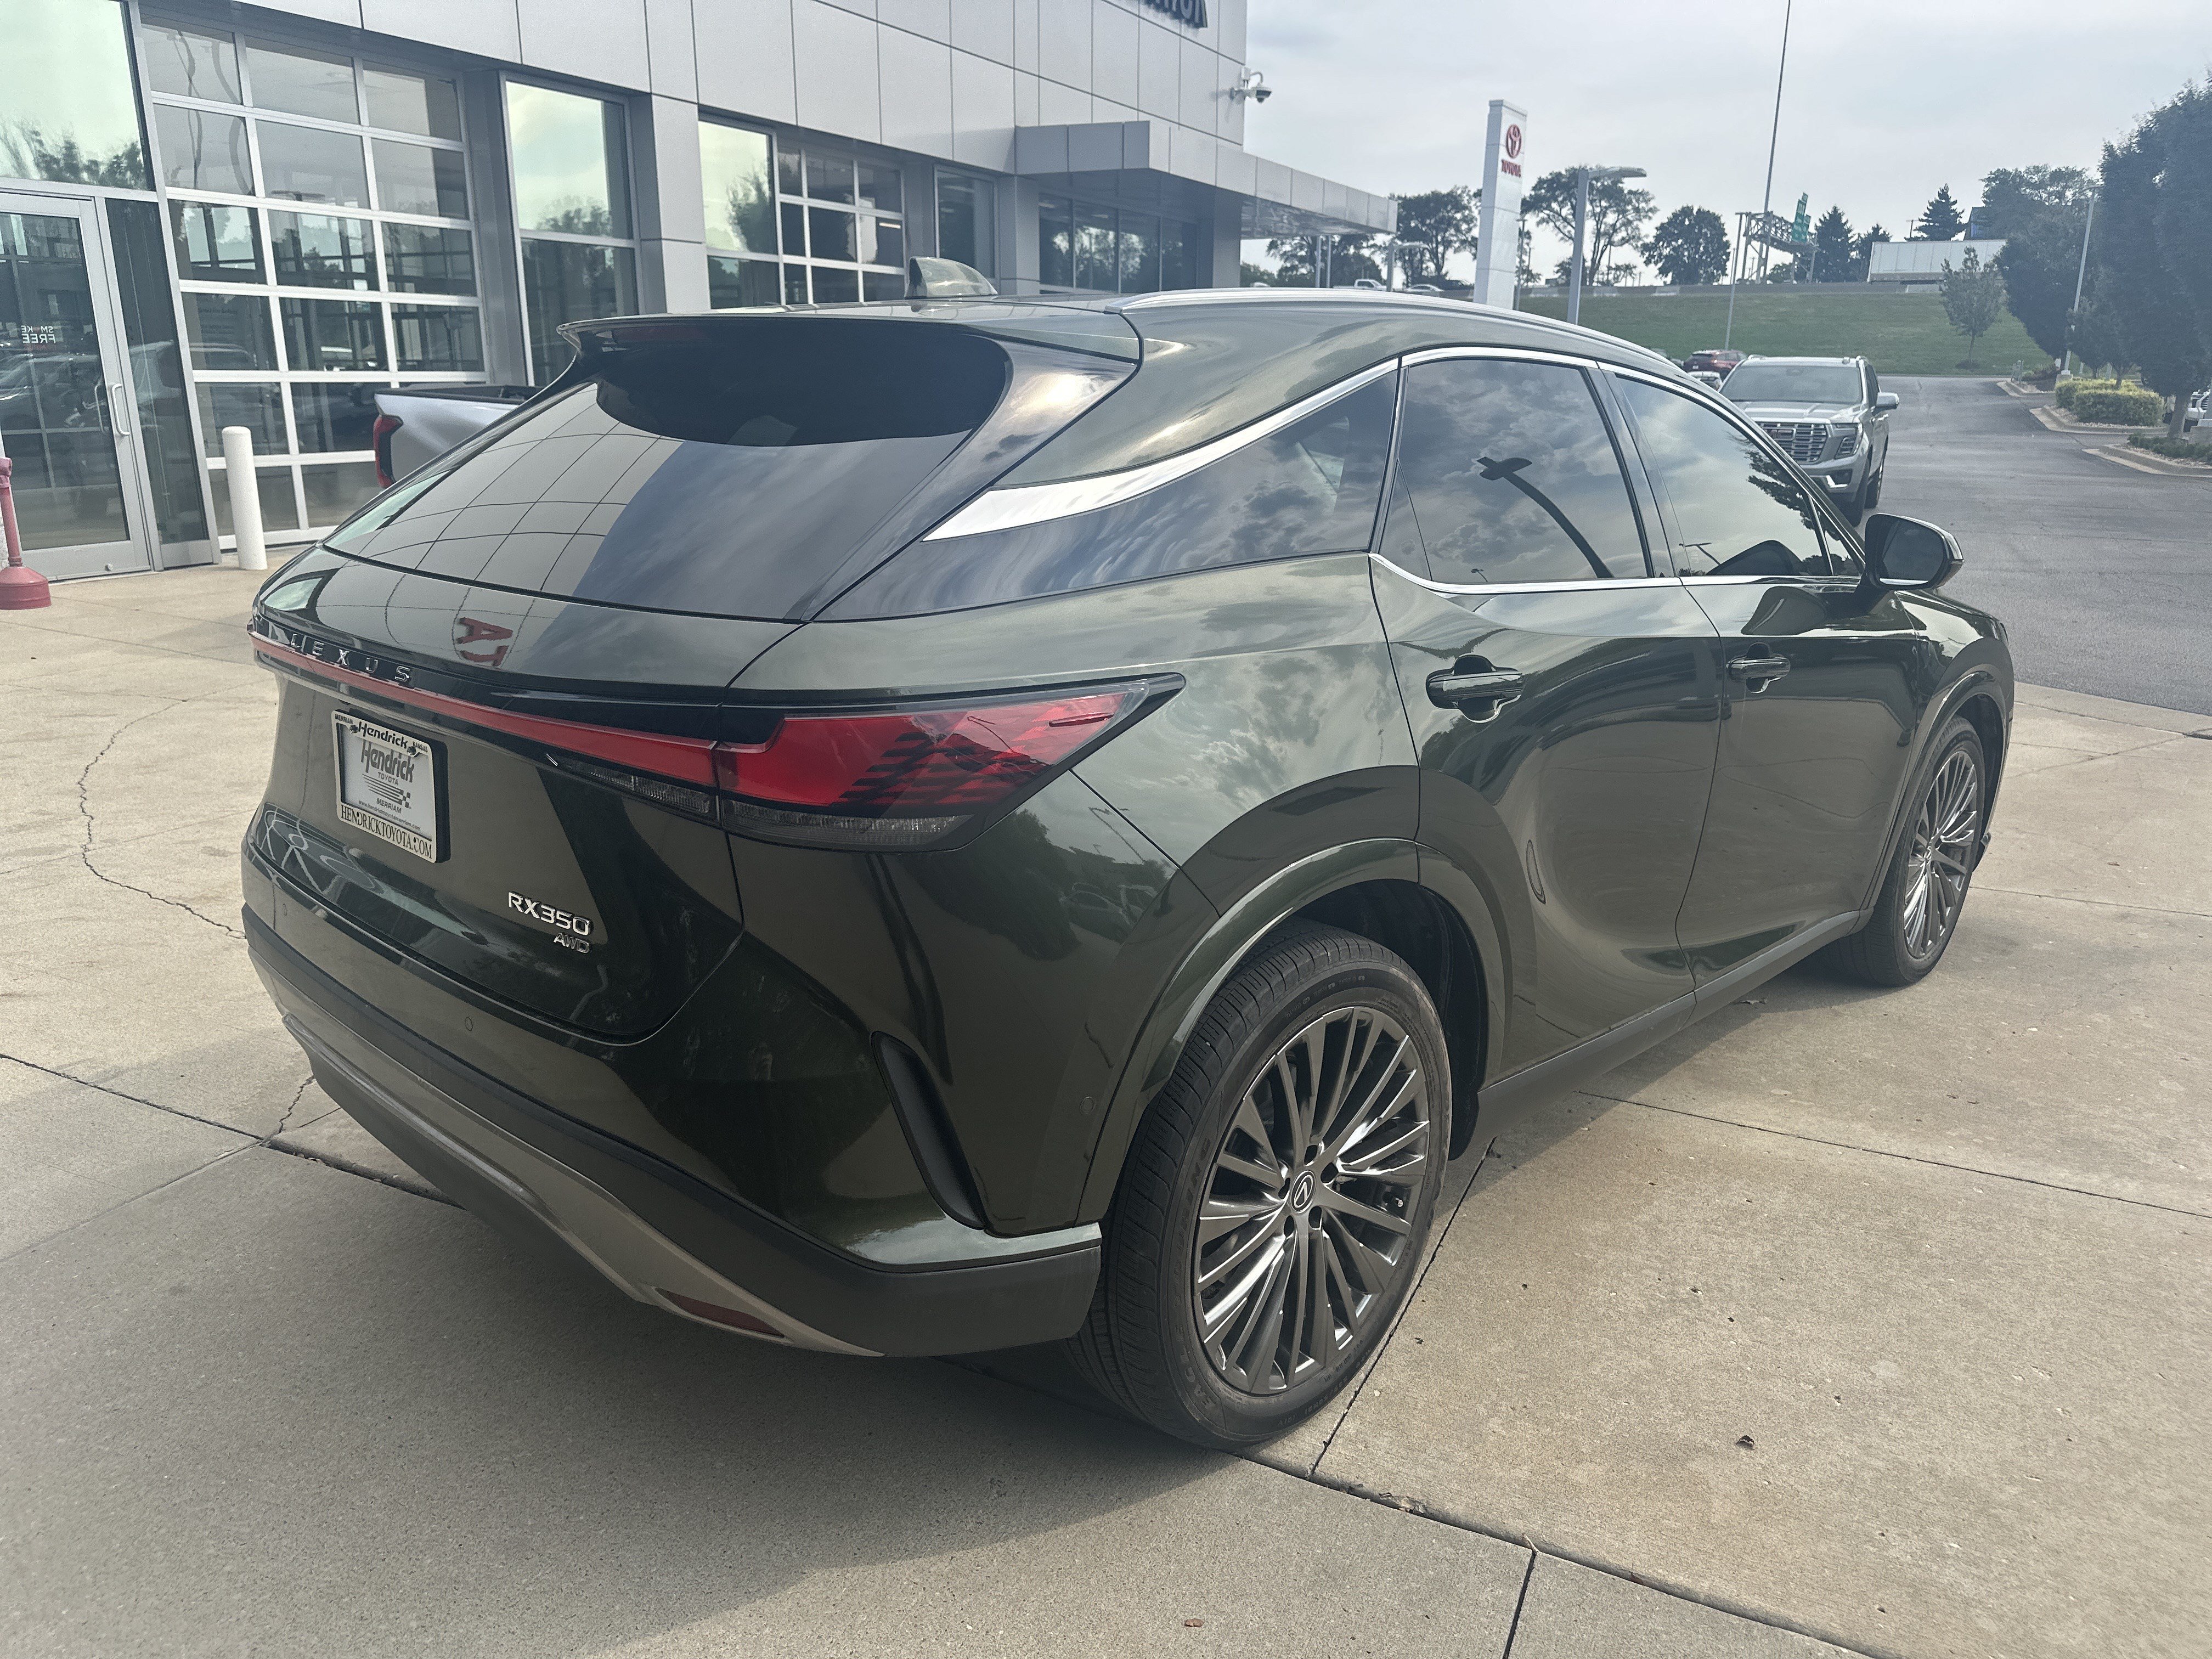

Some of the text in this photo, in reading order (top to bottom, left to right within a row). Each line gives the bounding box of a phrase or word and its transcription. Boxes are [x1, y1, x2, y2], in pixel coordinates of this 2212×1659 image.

[291, 633, 413, 683] LEXUS
[358, 721, 408, 749] Hendrick
[361, 740, 415, 783] Hendrick
[378, 771, 399, 786] TOYOTA
[376, 798, 402, 814] MERRIAM
[341, 804, 432, 859] HENDRICKTOYOTA.COM
[508, 891, 593, 936] RX350
[554, 932, 591, 954] AWD
